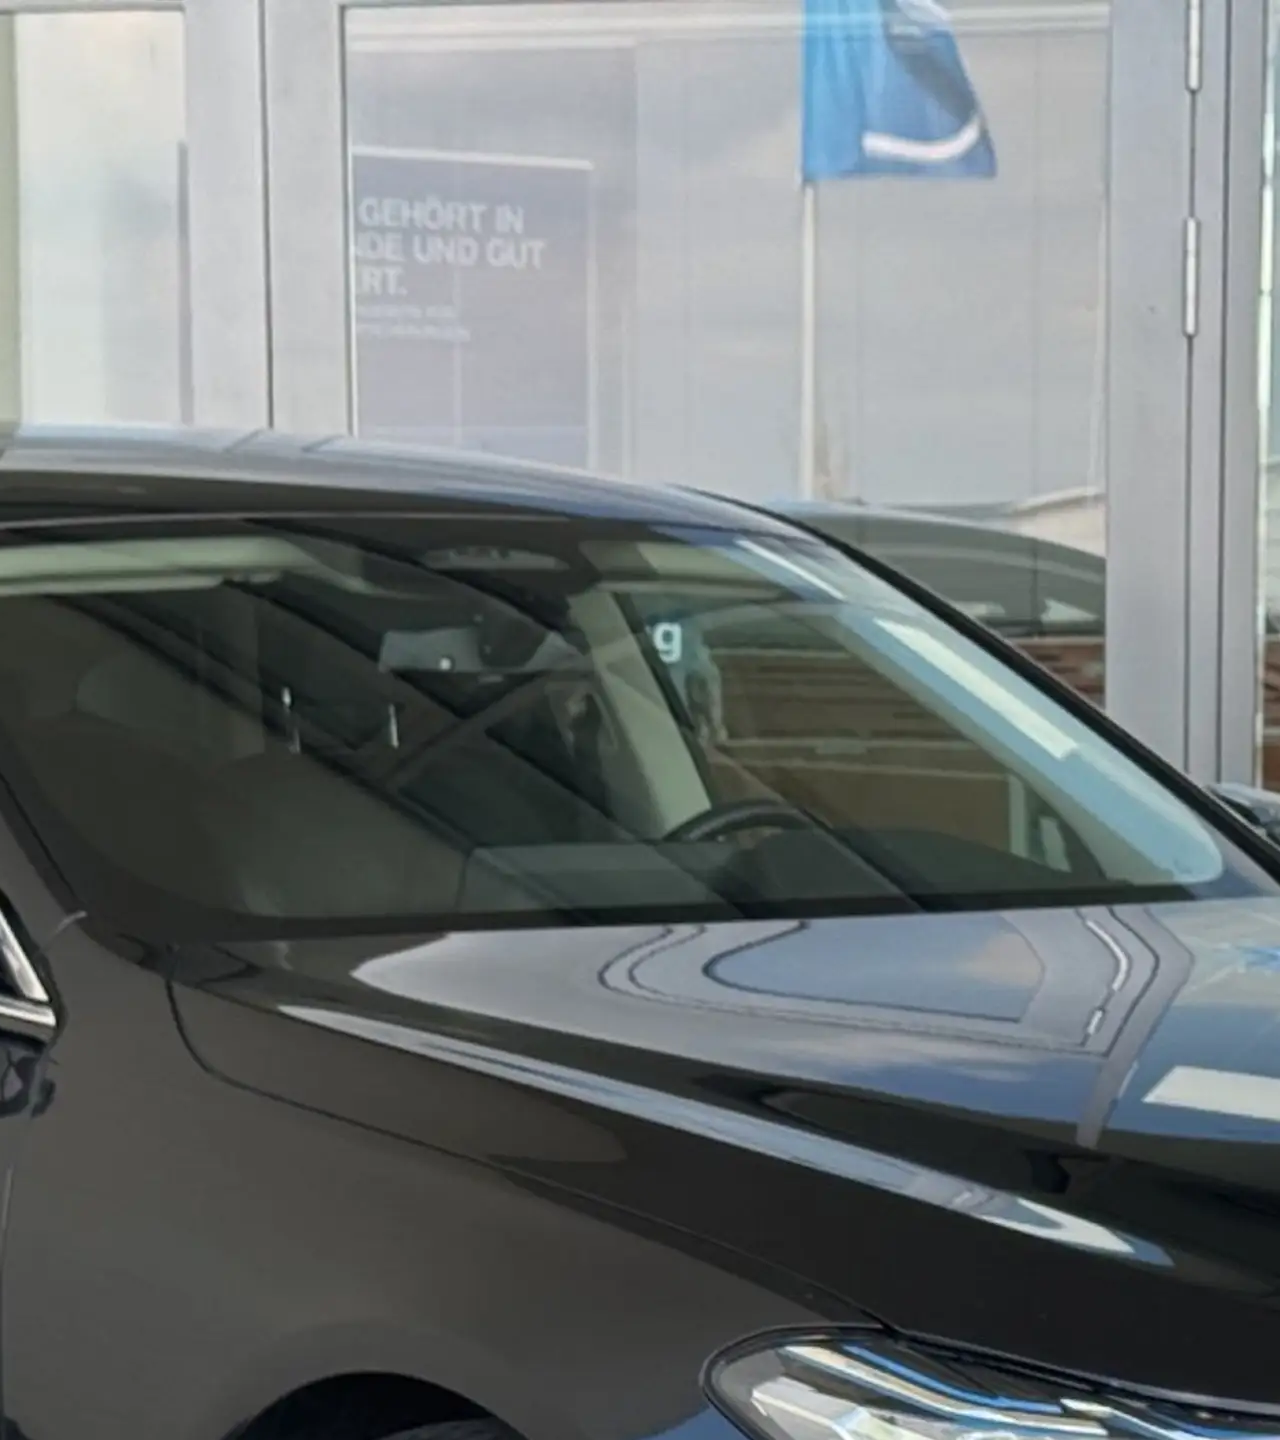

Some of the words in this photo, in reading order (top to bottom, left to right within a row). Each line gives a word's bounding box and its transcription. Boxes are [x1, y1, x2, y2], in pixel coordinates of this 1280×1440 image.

[495, 204, 524, 234] IN
[414, 235, 478, 265] UND
[487, 238, 545, 269] GUT
